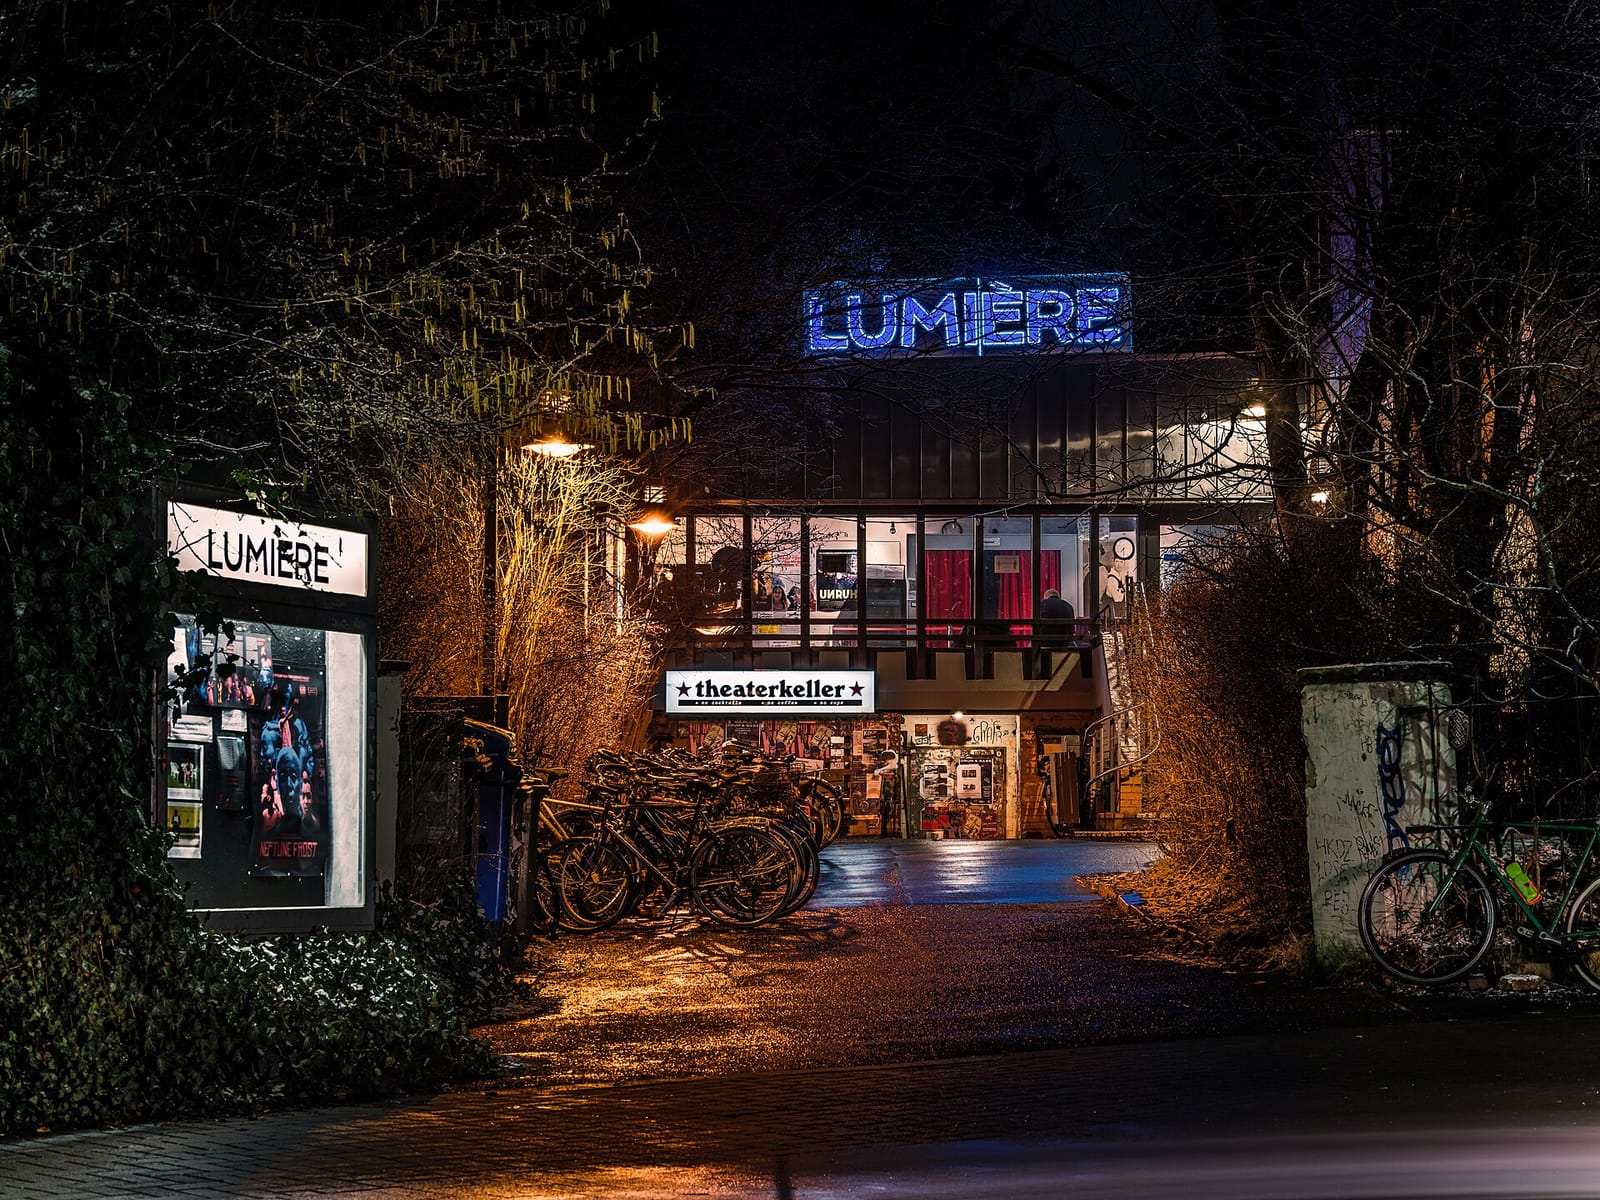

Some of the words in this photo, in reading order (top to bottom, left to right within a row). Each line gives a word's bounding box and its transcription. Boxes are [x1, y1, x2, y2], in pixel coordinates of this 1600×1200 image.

[808, 281, 1121, 350] LUMIÈRE
[207, 528, 329, 584] LUMIÈRE
[695, 679, 845, 698] theaterkeller
[259, 840, 292, 857] NEPTUNE
[292, 841, 319, 858] FROST
